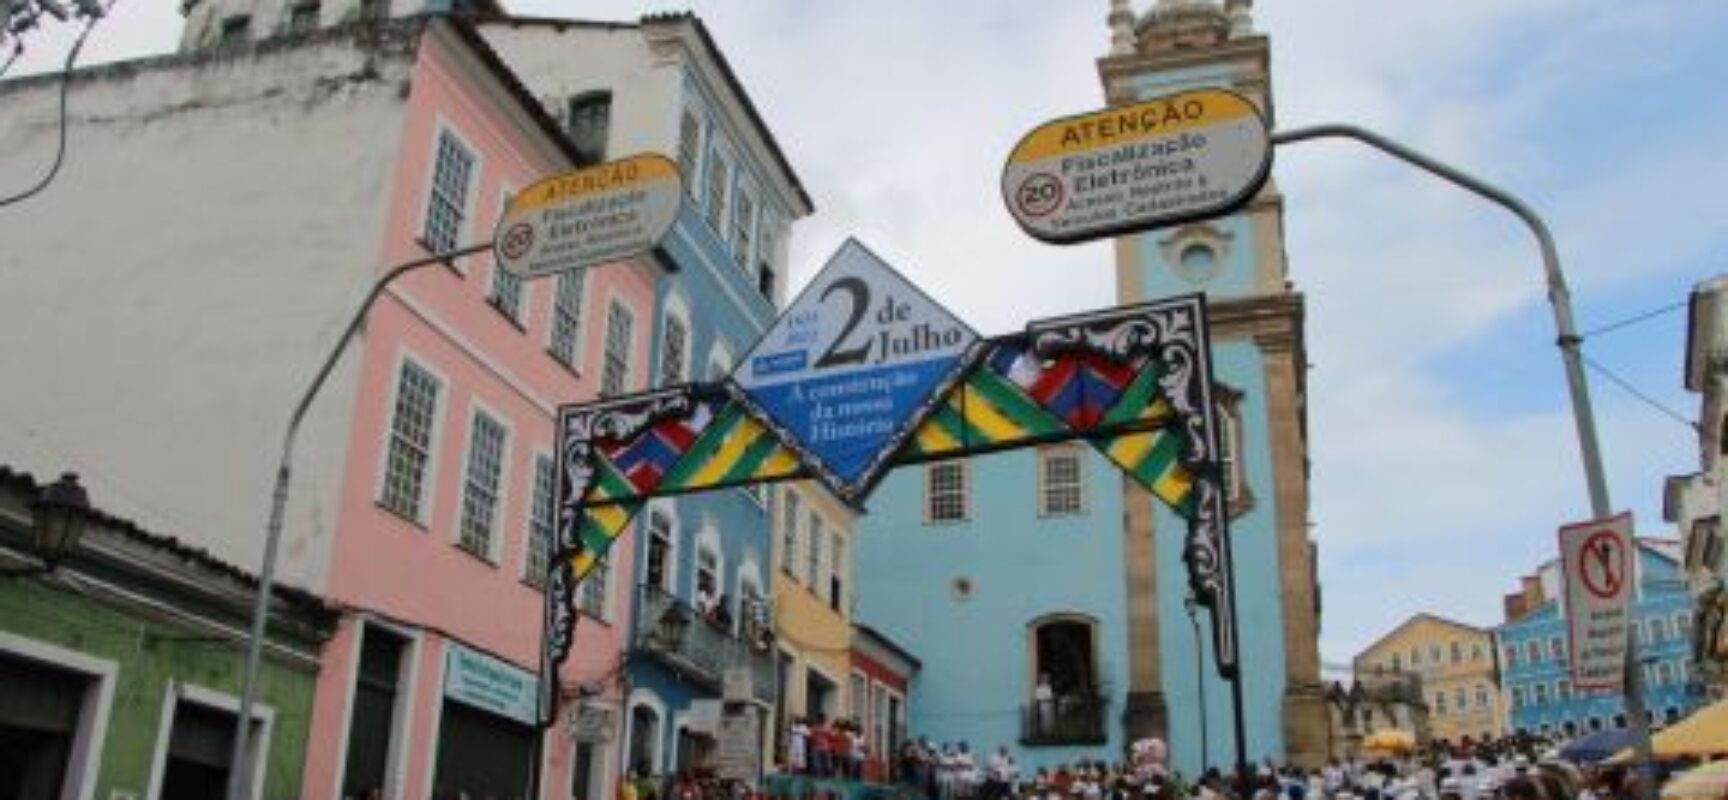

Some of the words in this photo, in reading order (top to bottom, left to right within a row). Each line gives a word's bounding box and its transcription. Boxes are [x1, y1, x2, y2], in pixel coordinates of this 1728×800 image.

[1061, 100, 1205, 148] ATENÇÃO
[1061, 134, 1207, 175] Fiscalização
[544, 163, 639, 201] ATENÇÃO
[1024, 183, 1057, 205] 20
[1073, 158, 1196, 194] Eletrônica
[815, 278, 872, 369] 2
[877, 294, 912, 325] de
[873, 323, 963, 364] Julho
[810, 401, 833, 420] da
